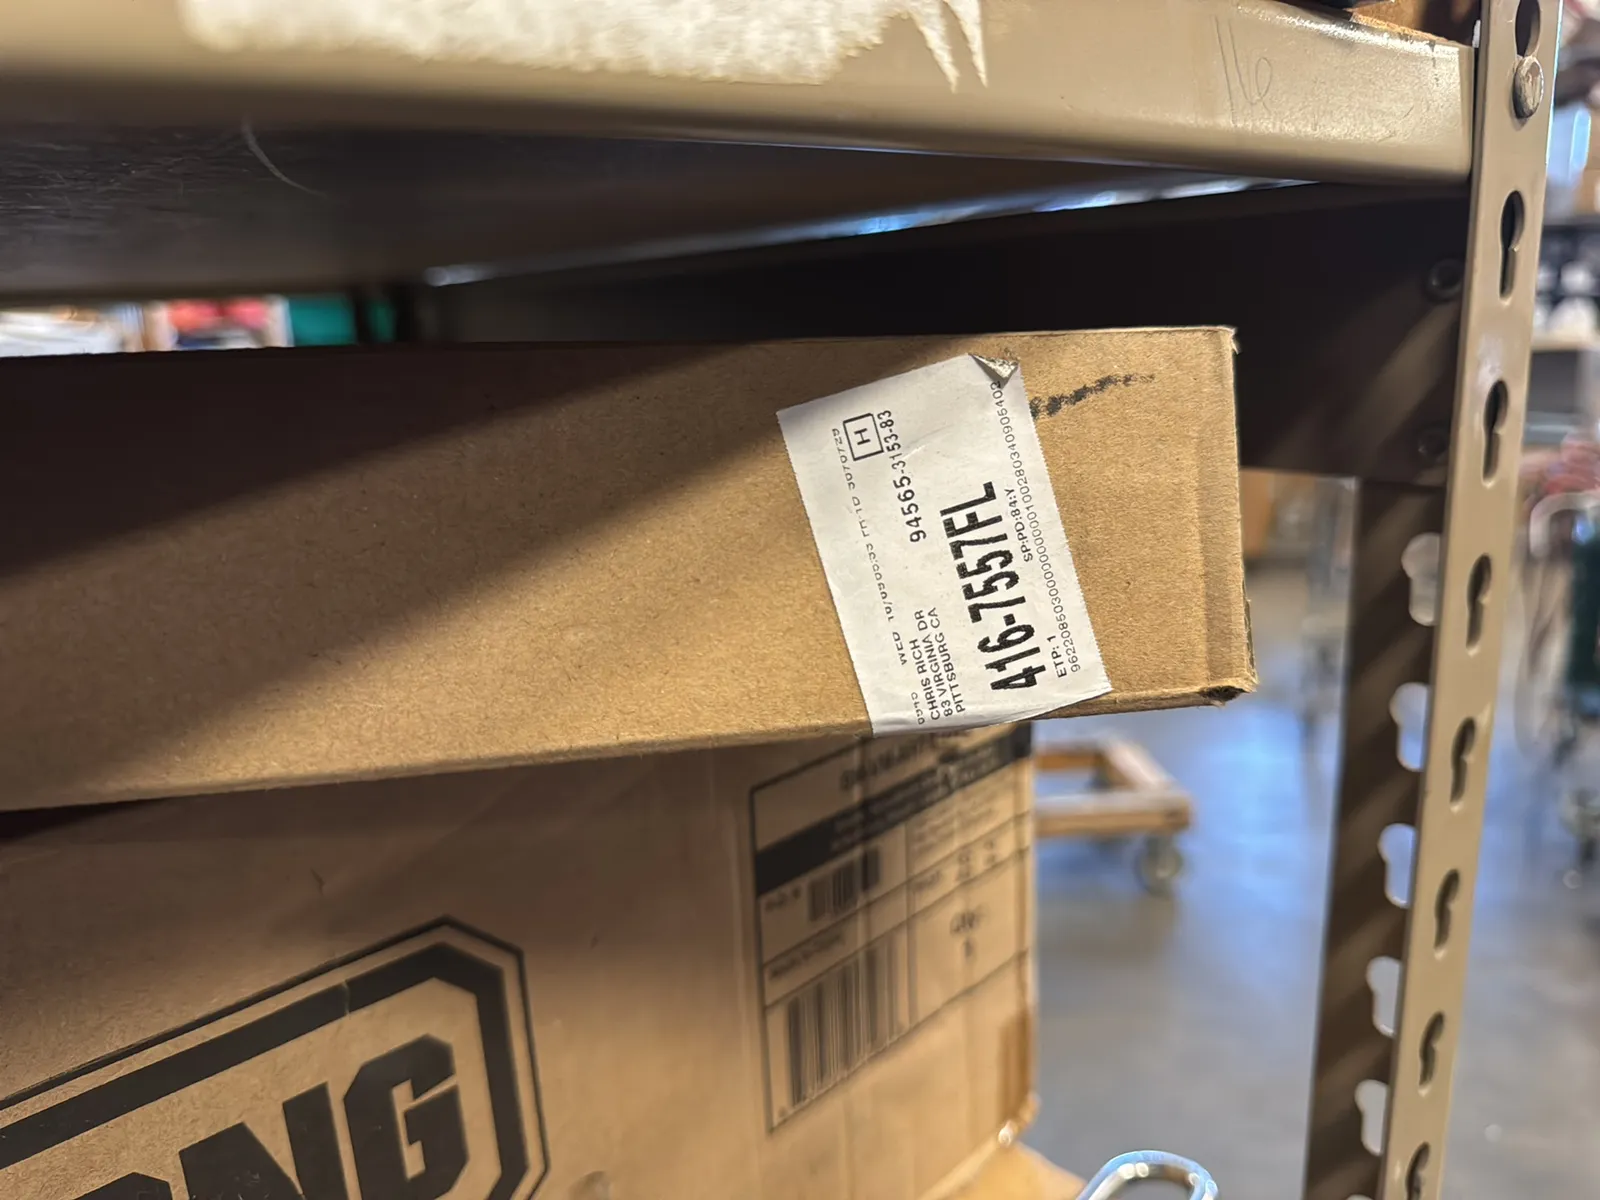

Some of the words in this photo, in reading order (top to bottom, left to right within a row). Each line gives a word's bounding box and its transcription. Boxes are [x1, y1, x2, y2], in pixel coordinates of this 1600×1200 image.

[853, 428, 871, 445] H
[877, 410, 927, 542] 94565-3153-83
[1004, 489, 1033, 562] SP:PD:84:Y
[914, 610, 928, 631] DR
[928, 607, 940, 629] CA
[909, 639, 927, 674] RICH
[922, 633, 947, 697] VIRGINIA
[935, 632, 966, 713] PITTSBURG
[1051, 646, 1067, 678] ETP:
[921, 677, 940, 720] CHRIS
[940, 700, 953, 717] 83
